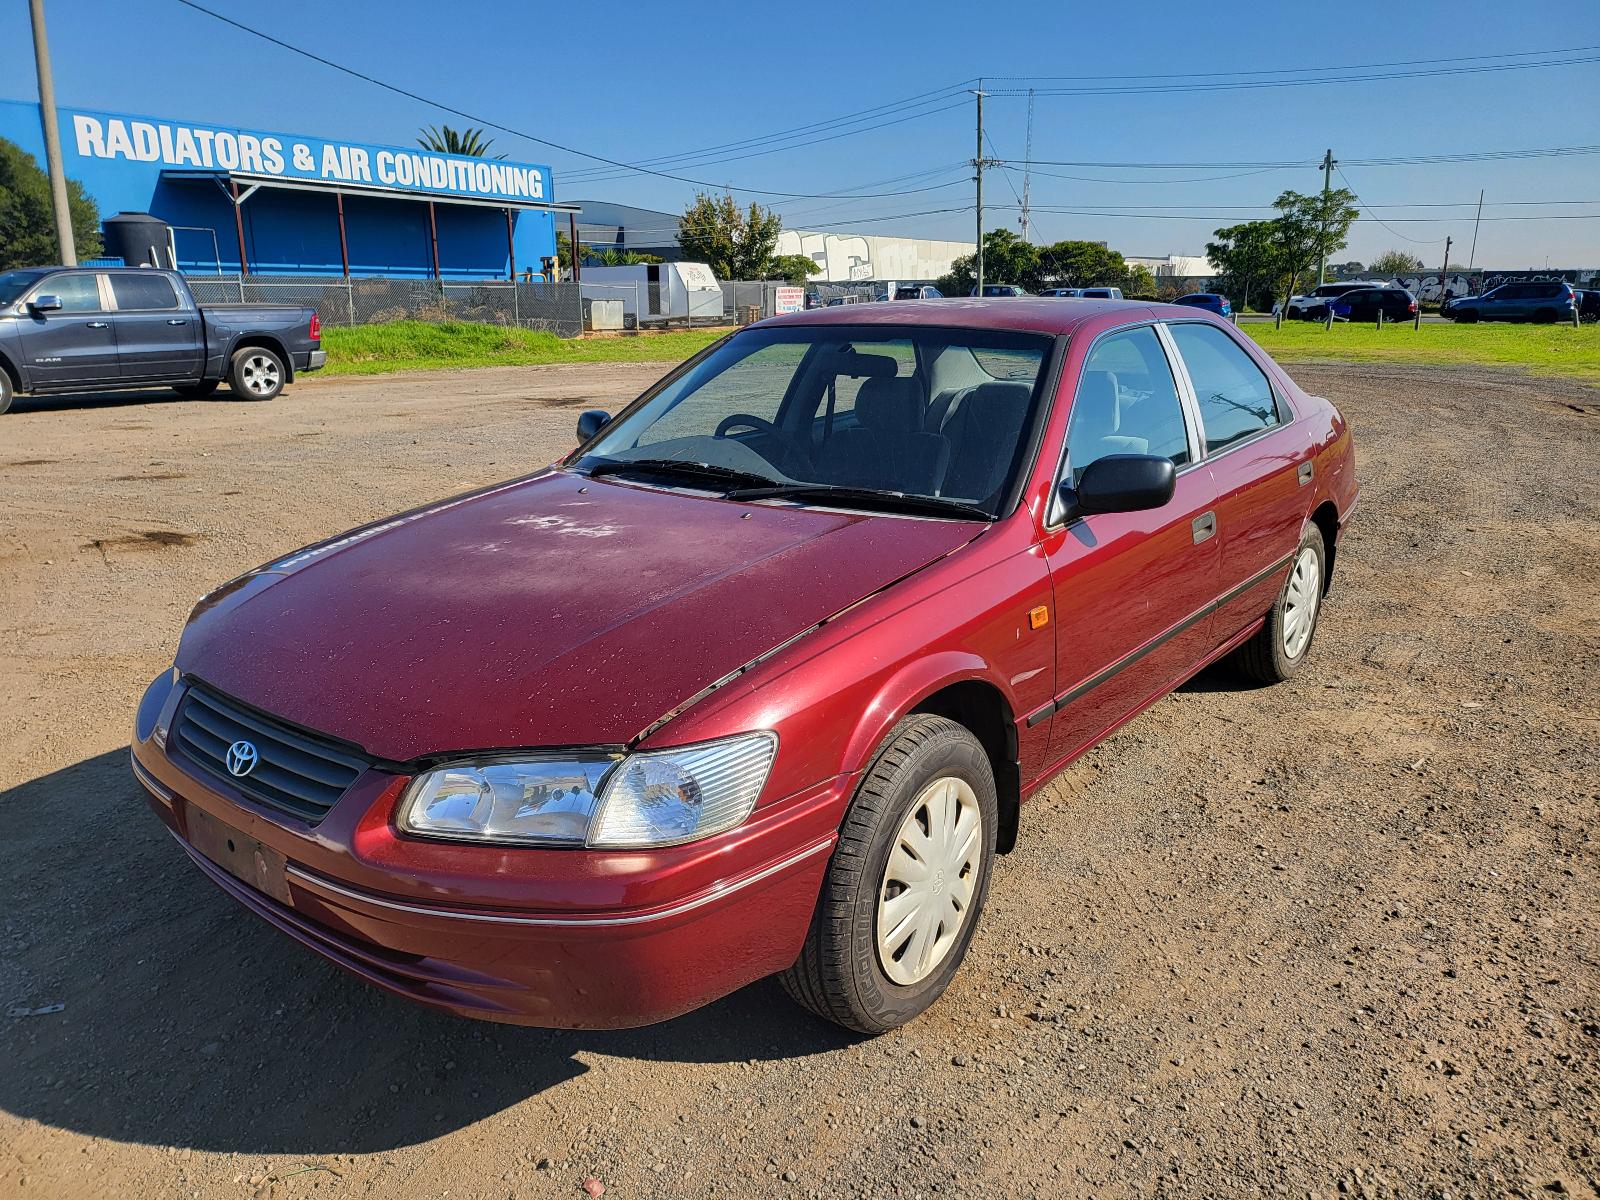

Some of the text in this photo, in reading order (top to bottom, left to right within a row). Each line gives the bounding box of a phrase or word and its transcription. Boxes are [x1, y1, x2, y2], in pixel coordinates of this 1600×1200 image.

[73, 114, 543, 198] RADIATORS & AIR CONDITIONING
